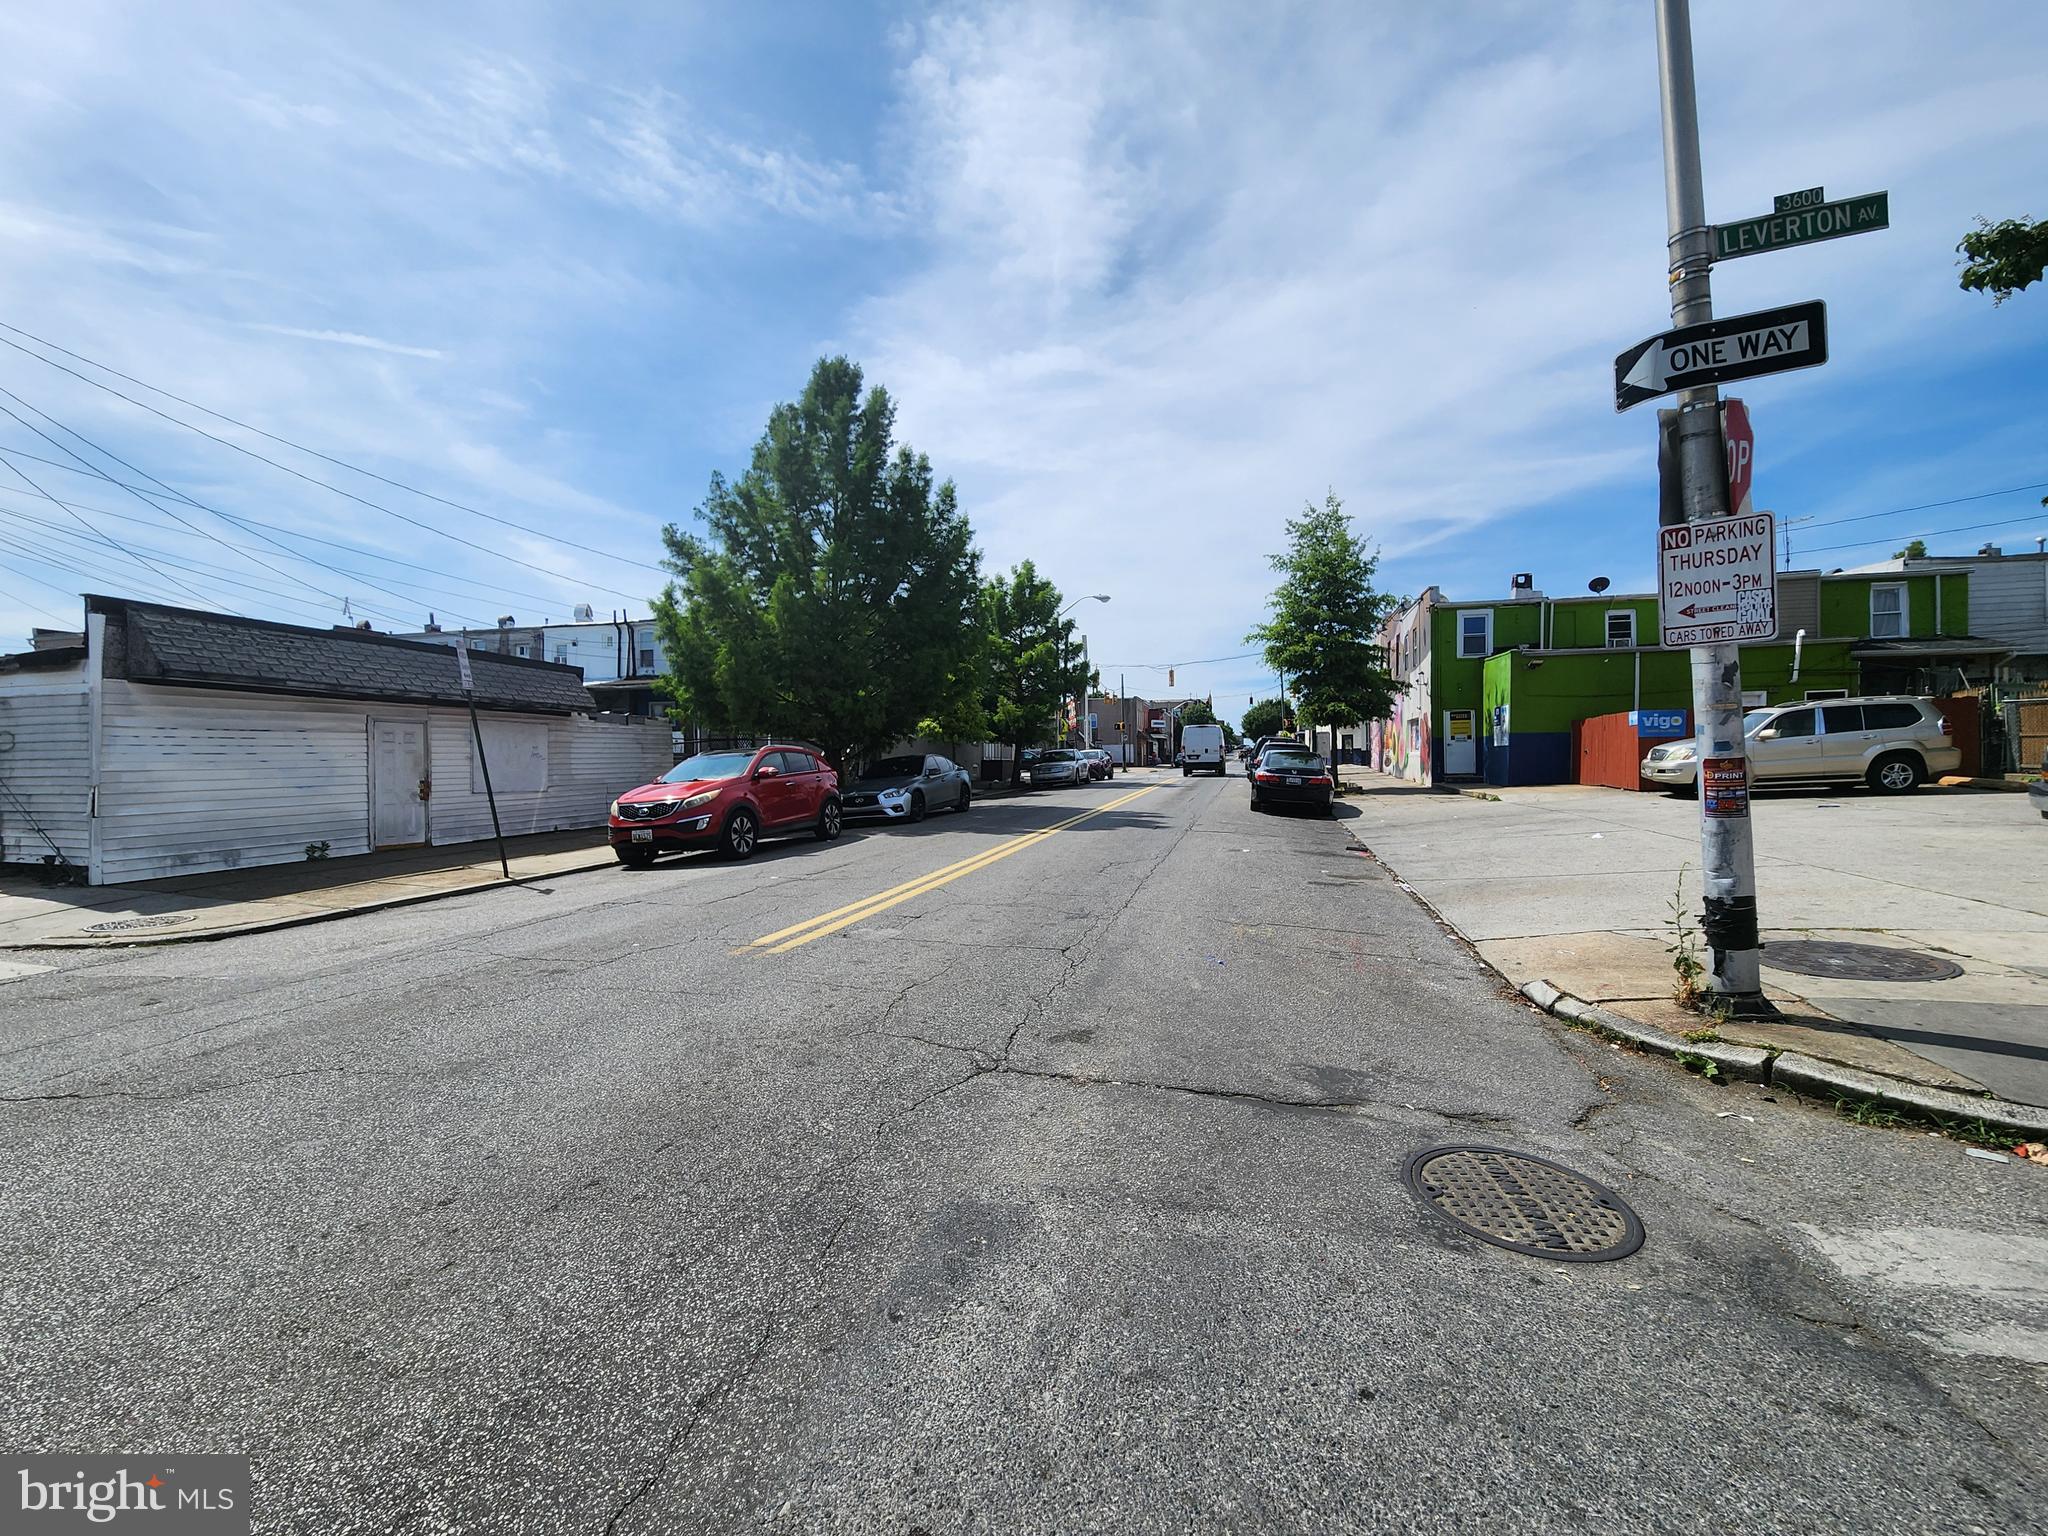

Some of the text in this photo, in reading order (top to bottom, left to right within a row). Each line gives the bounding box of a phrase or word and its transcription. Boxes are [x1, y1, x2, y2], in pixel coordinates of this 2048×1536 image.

[1782, 188, 1822, 210] 3600
[1722, 203, 1879, 253] LEVERTON AV
[1670, 325, 1800, 372] ONE WAY
[1728, 439, 1750, 483] OP
[1664, 519, 1766, 549] NO PARKING
[1670, 543, 1763, 571] THURSDAY
[1669, 630, 1696, 643] CARS
[1739, 622, 1768, 636] AWAY
[1642, 713, 1682, 729] vigo
